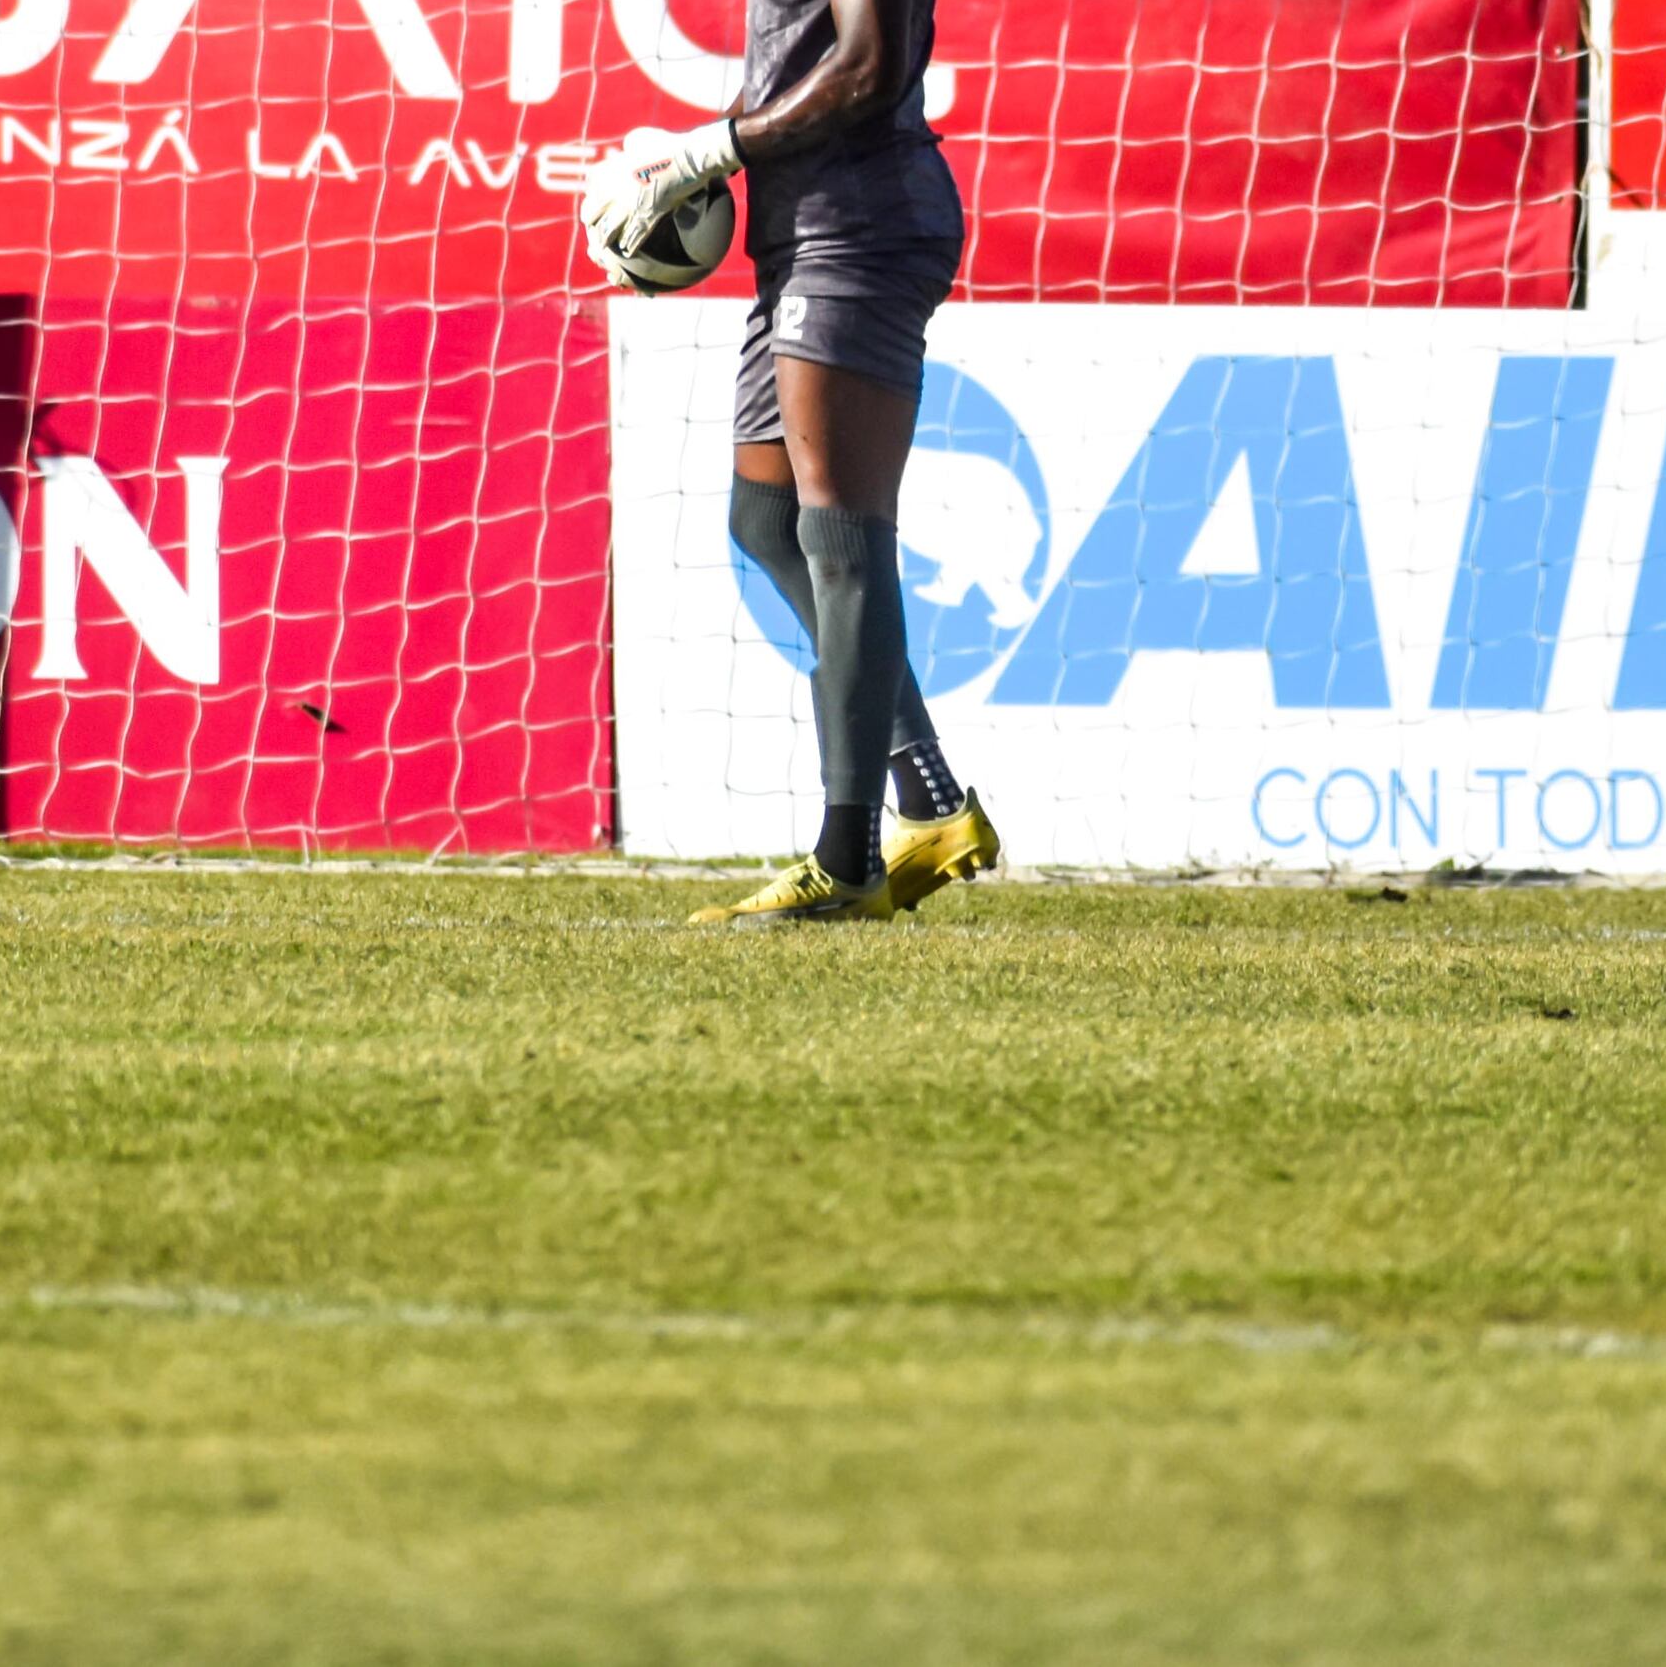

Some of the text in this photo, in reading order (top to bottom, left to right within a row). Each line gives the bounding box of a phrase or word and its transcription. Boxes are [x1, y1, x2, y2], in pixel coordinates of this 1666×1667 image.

[248, 126, 359, 184] LA
[407, 137, 627, 194] AVE
[1251, 766, 1439, 851] CON
